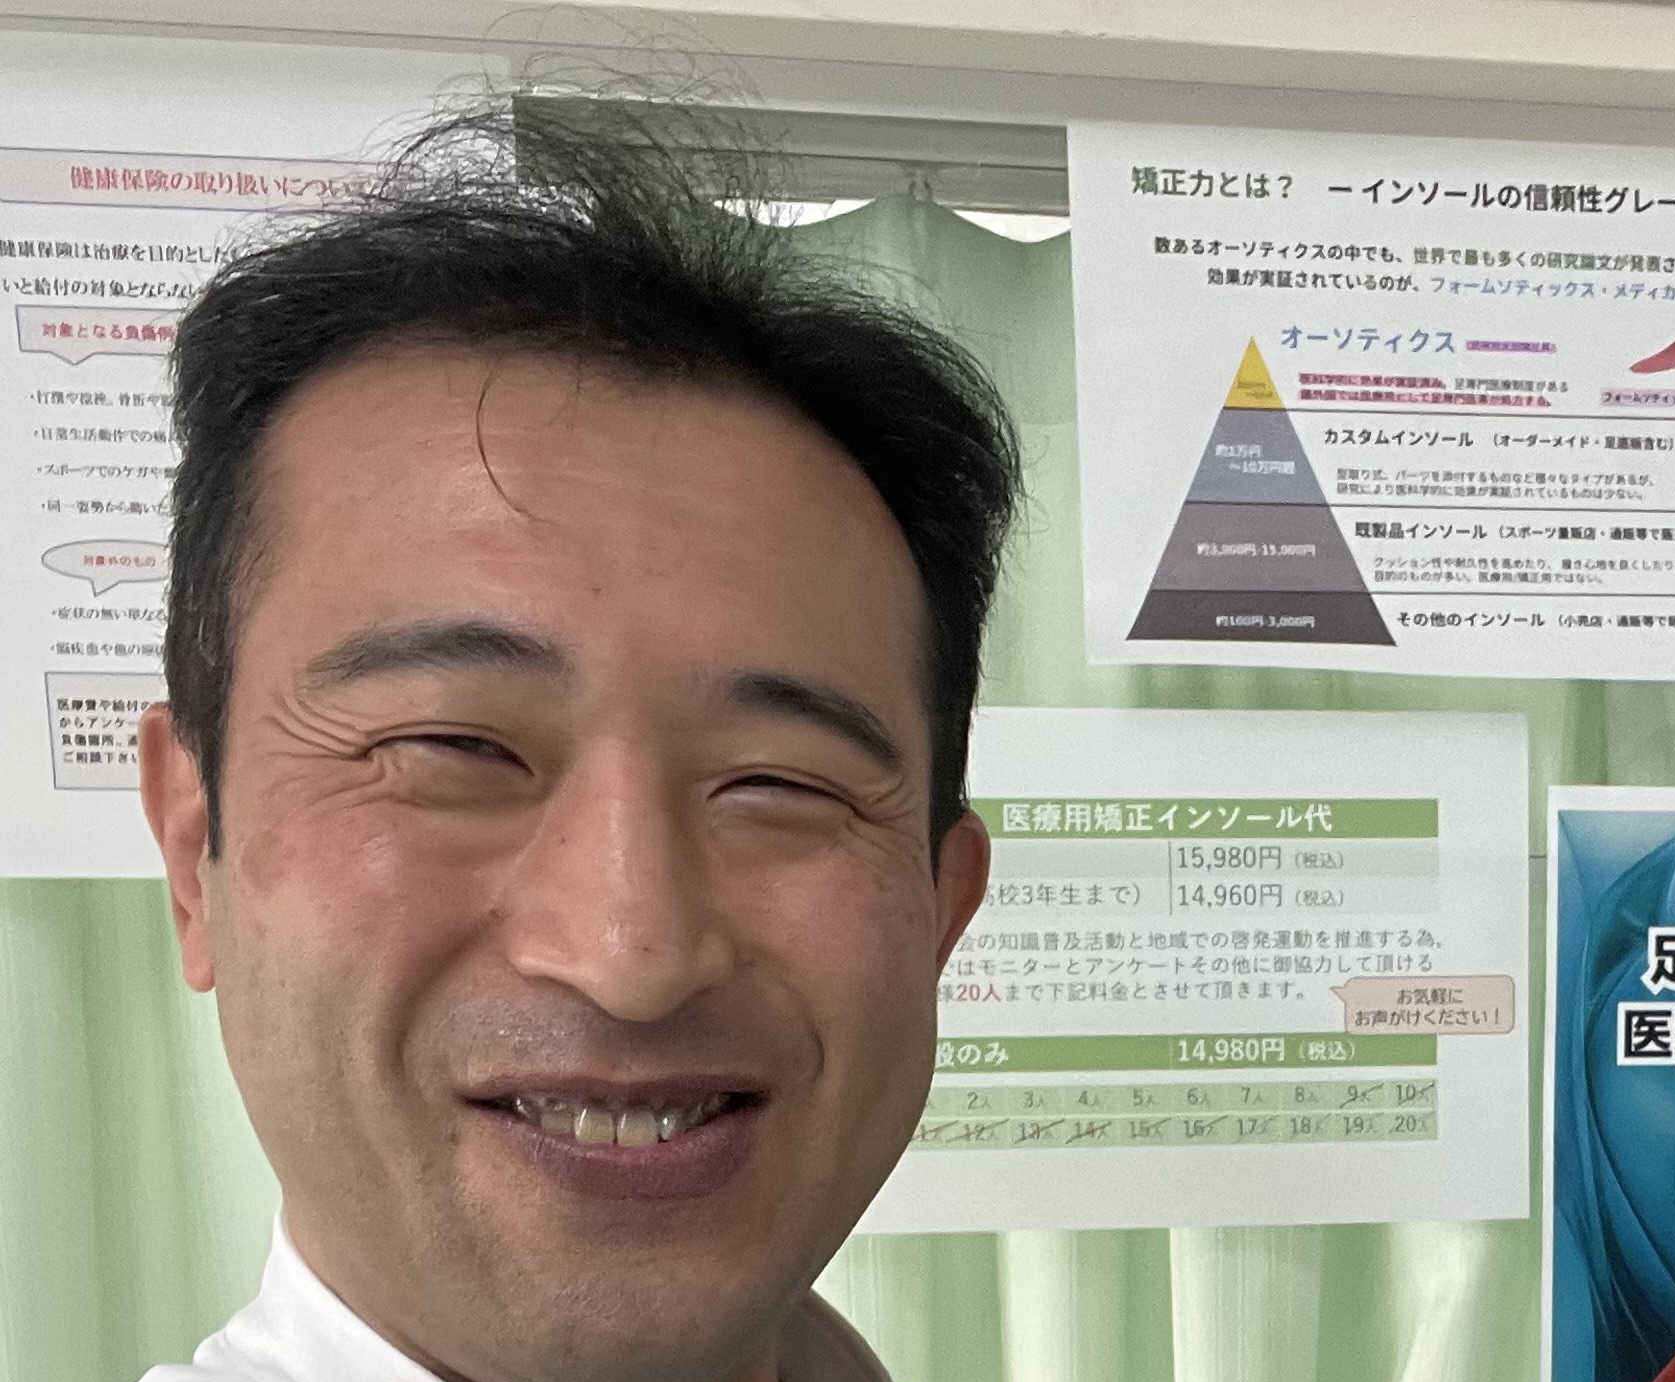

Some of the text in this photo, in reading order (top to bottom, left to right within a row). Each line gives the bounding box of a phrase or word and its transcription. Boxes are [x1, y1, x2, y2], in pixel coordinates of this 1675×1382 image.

[1132, 166, 1294, 200] 矯正力とは？
[1281, 325, 1456, 354] オーソティクス
[1324, 428, 1475, 448] カスタムインソール
[1398, 612, 1546, 628] その他のインソール
[1002, 803, 1334, 834] 医療用矯正インソール代
[1177, 845, 1283, 871] 15,980円
[1177, 882, 1283, 908] 14,960円
[1397, 987, 1464, 1005] お気軽に
[1178, 1037, 1285, 1066] 14,980円
